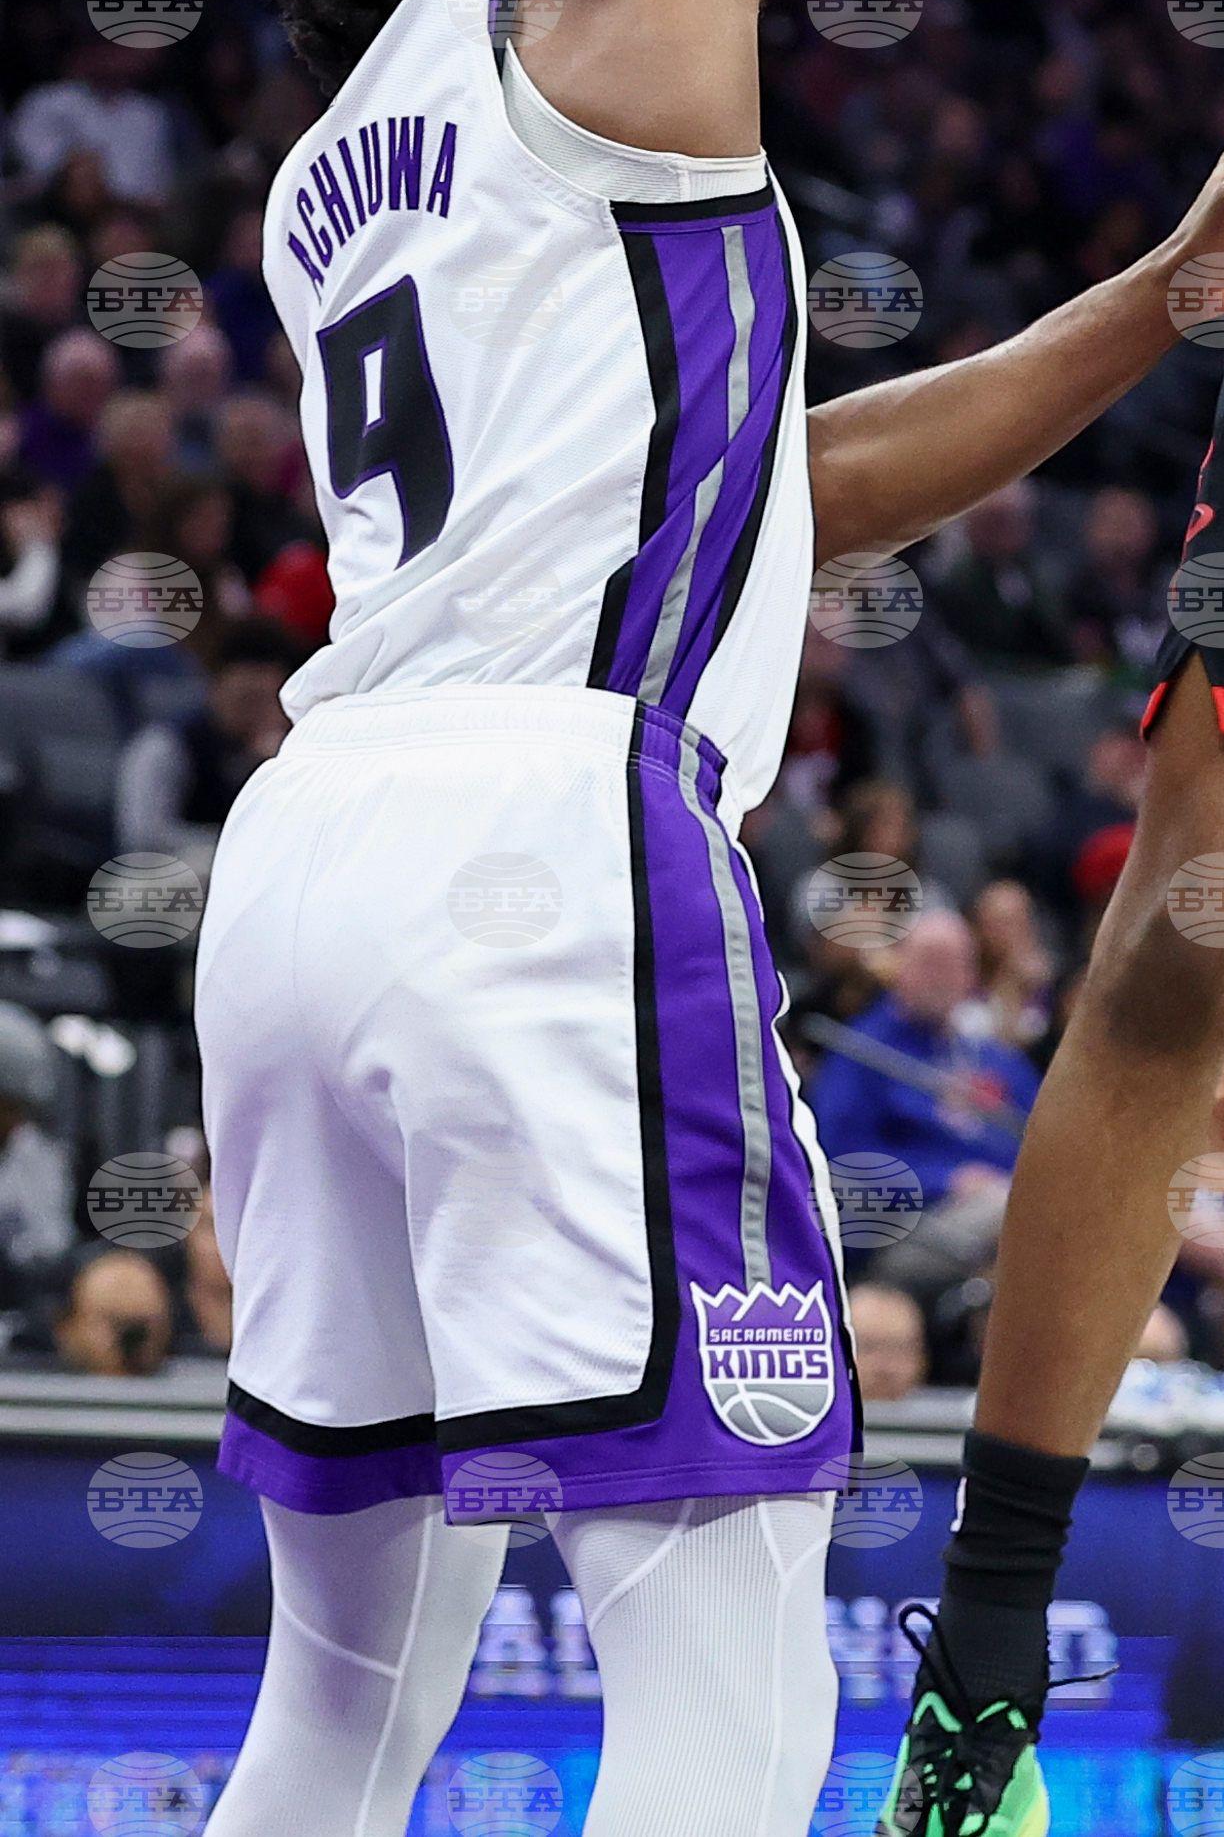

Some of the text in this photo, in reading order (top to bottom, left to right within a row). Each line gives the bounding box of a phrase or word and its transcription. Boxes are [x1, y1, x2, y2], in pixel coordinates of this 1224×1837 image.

[286, 115, 457, 306] ACHIUWA
[316, 273, 455, 572] 9
[707, 1349, 829, 1379] KINGS
[708, 1328, 824, 1344] SACRAMENTO
